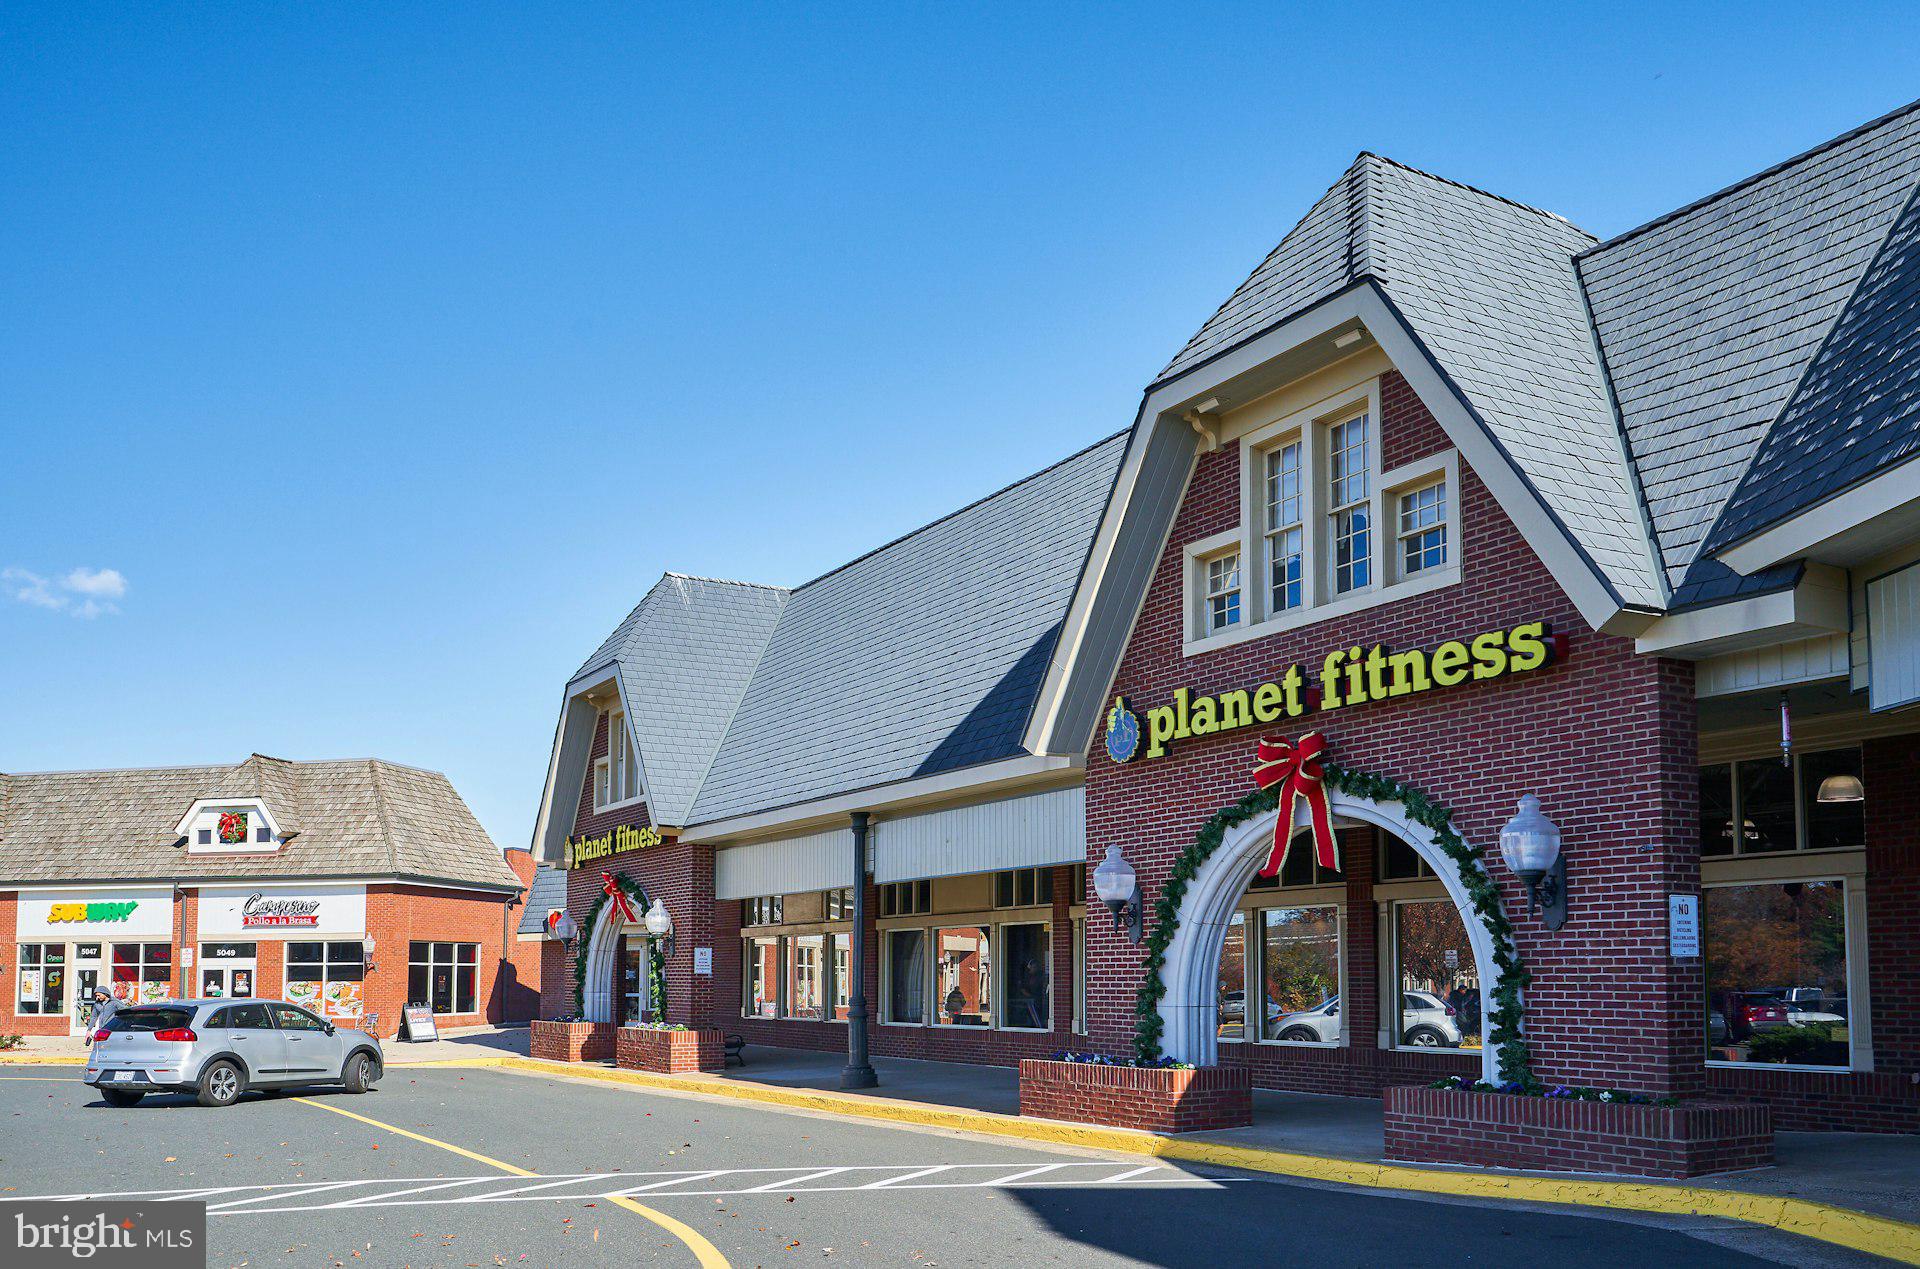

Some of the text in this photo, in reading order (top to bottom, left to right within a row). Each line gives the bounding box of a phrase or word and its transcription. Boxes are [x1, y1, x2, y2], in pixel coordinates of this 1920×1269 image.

[1147, 620, 1554, 759] planet fitness
[574, 829, 613, 869] planet
[47, 900, 138, 925] SUBWAY
[1678, 903, 1689, 915] NO
[248, 916, 270, 925] Pollo
[279, 916, 287, 925] la
[289, 916, 312, 925] Brasa
[46, 954, 64, 962] Open
[216, 949, 236, 957] 5049
